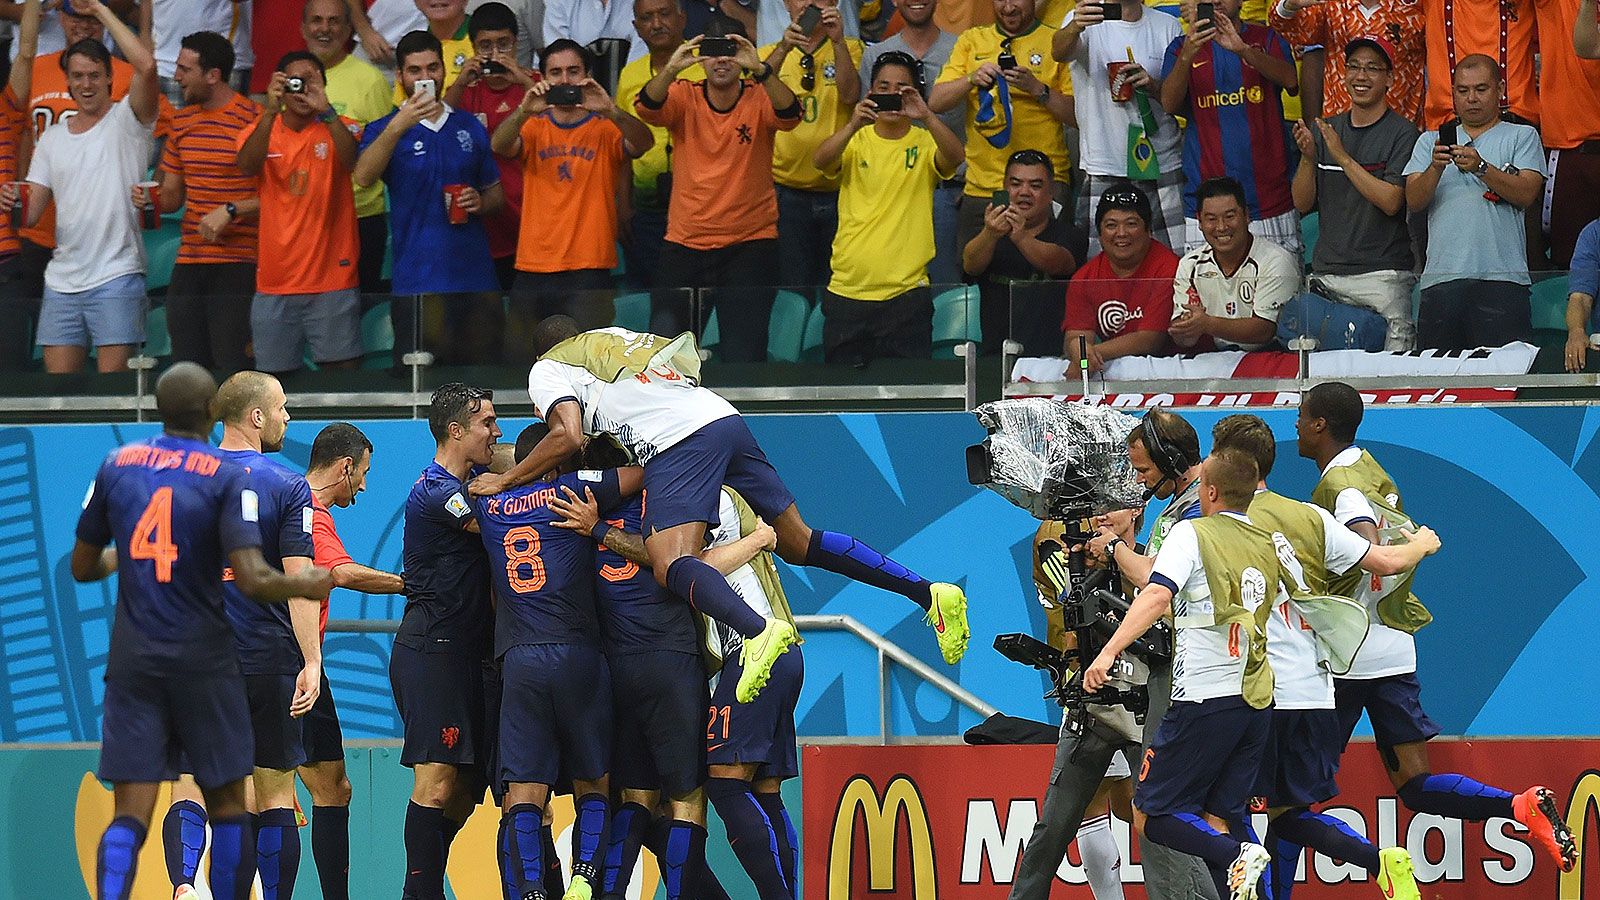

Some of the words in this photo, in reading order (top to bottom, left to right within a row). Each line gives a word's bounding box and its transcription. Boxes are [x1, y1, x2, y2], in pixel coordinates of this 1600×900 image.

[1197, 86, 1245, 109] unicef
[130, 486, 178, 583] 4
[502, 525, 547, 594] 8
[706, 705, 732, 739] 21
